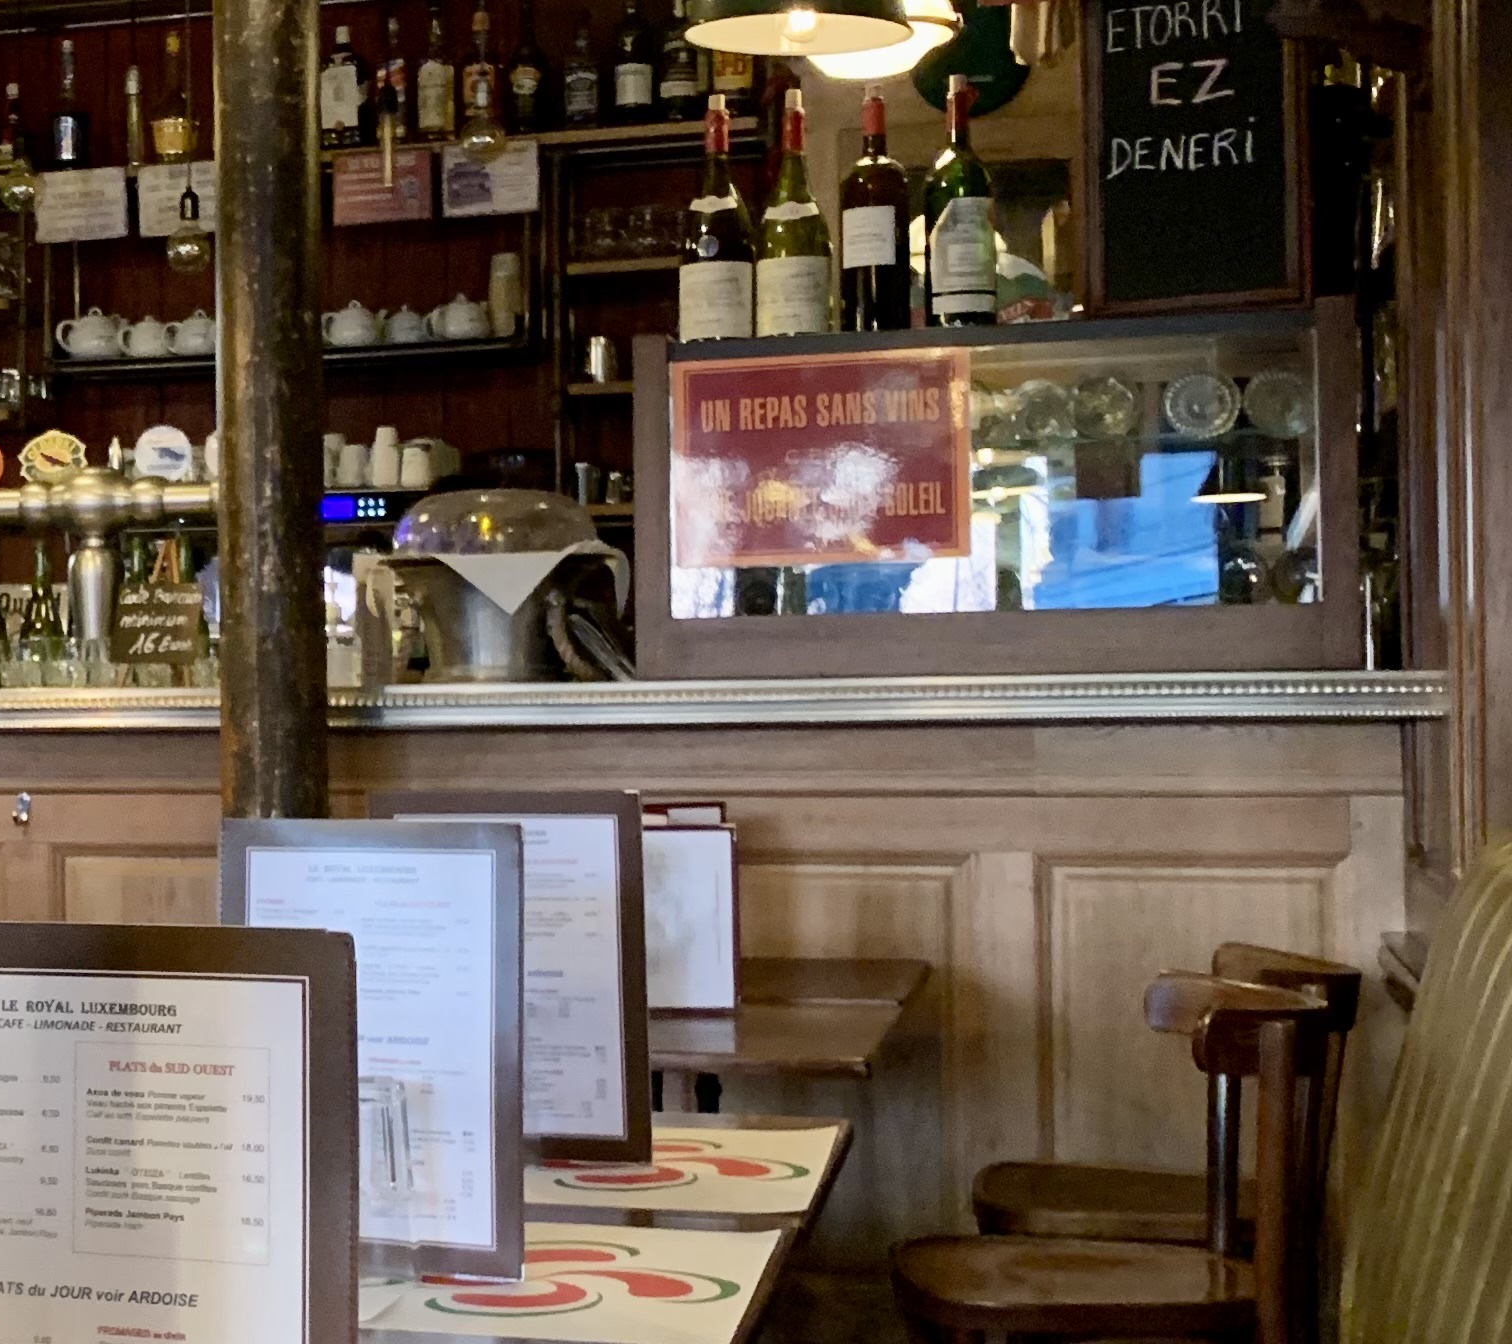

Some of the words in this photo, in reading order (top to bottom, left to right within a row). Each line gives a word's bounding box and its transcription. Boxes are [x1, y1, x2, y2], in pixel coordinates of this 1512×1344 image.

[1150, 58, 1235, 105] EZ
[701, 399, 731, 433] UN
[739, 394, 807, 431] REPAS
[816, 391, 877, 428] SANS
[885, 387, 940, 423] VINS
[886, 481, 946, 517] SOLEIL
[128, 632, 160, 655] 16
[1, 1000, 18, 1012] LE
[25, 999, 74, 1014] ROYAL
[80, 1001, 177, 1017] LUXEMBOURG
[33, 1019, 96, 1031] LIMONADE
[104, 1021, 183, 1035] RESTAURANT
[108, 1060, 147, 1073] PLATS
[165, 1063, 191, 1074] SUD
[193, 1064, 236, 1076] OUEST
[27, 1282, 46, 1297] du
[50, 1284, 92, 1300] JOUR
[95, 1289, 125, 1303] voir
[127, 1290, 200, 1308] ARDOISE
